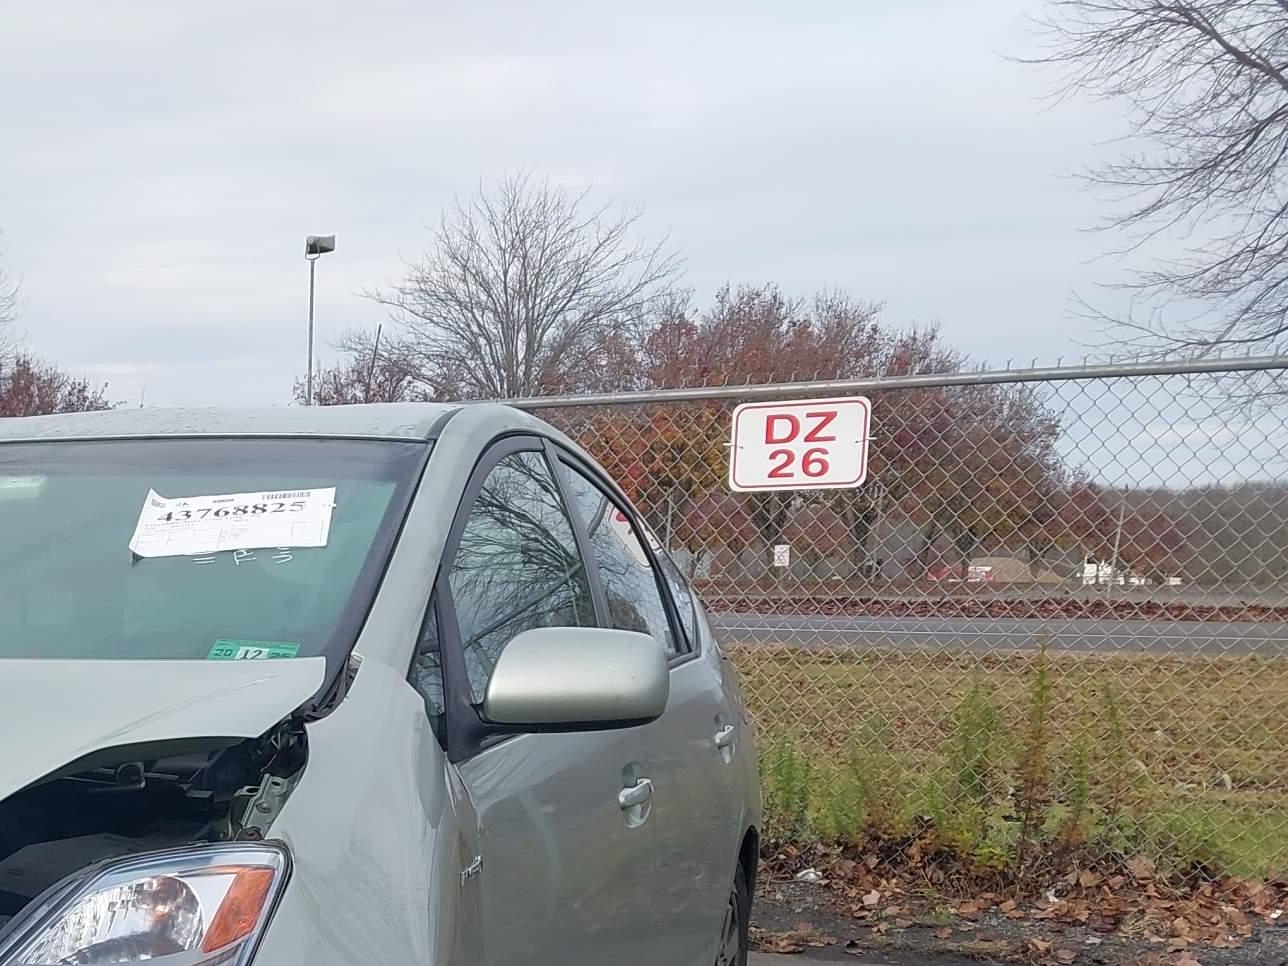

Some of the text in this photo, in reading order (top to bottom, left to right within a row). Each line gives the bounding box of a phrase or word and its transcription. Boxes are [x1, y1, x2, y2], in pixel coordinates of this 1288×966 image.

[765, 411, 838, 444] DZ
[767, 447, 830, 478] 26
[156, 501, 305, 522] 43768825
[239, 649, 263, 660] 12
